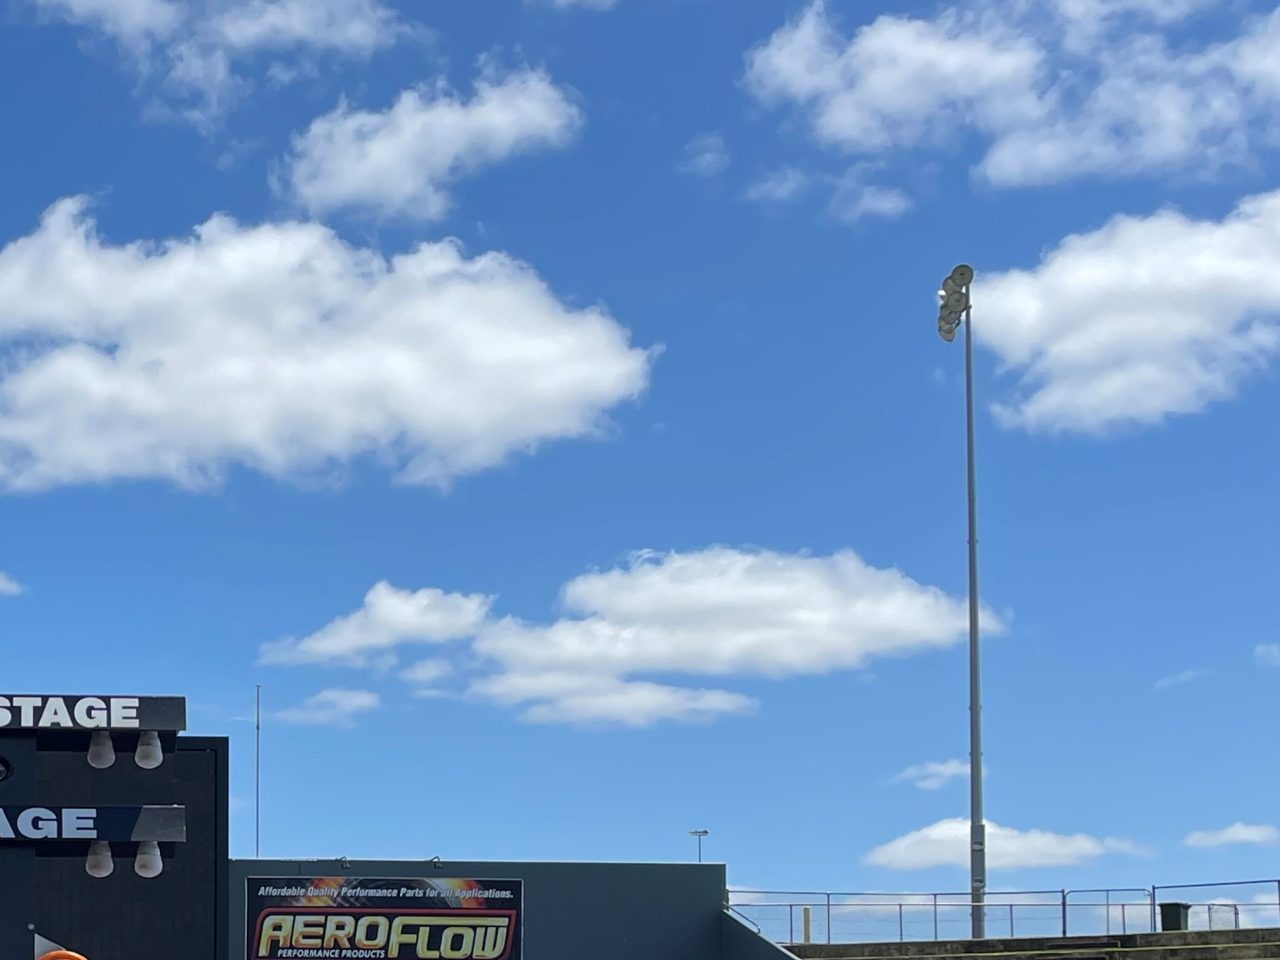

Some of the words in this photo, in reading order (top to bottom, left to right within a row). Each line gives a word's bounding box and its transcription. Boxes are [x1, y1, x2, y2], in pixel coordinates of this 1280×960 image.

[258, 886, 305, 896] Affordable
[307, 887, 338, 898] Quality
[341, 887, 397, 897] Performance
[400, 887, 423, 897] Parts
[426, 888, 439, 897] for
[258, 915, 509, 960] AEROFLOW
[277, 949, 340, 958] PERFORMANCE
[341, 950, 386, 959] PRODUCTS
